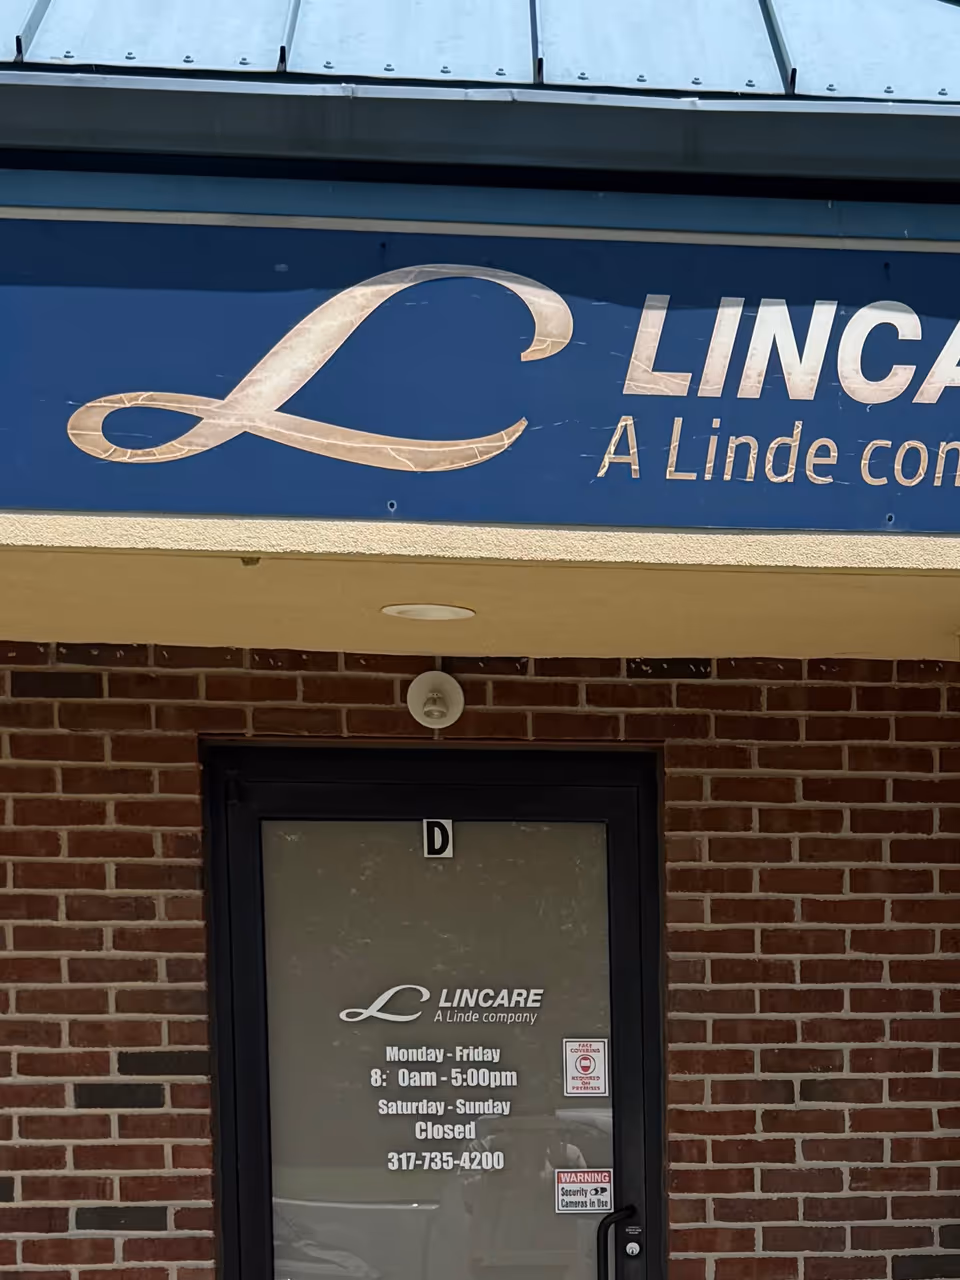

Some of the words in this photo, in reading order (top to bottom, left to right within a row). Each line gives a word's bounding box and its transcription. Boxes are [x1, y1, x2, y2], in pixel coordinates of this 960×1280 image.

[596, 416, 640, 479] A
[665, 417, 839, 485] Linde
[426, 820, 450, 856] D
[438, 988, 544, 1008] LINCARE
[433, 1010, 443, 1023] A
[446, 1010, 479, 1023] Linde
[482, 1011, 538, 1025] company
[385, 1046, 445, 1063] Monday
[455, 1046, 501, 1063] Friday
[450, 1068, 518, 1089] 5:00pm
[377, 1099, 445, 1116] Saturday
[455, 1098, 511, 1116] Sunday
[414, 1121, 476, 1140] Closed
[387, 1151, 505, 1171] 317-735-4200
[560, 1172, 610, 1183] WARNING
[560, 1186, 589, 1199] Security
[560, 1198, 588, 1208] Cameras
[597, 1198, 608, 1208] Use
